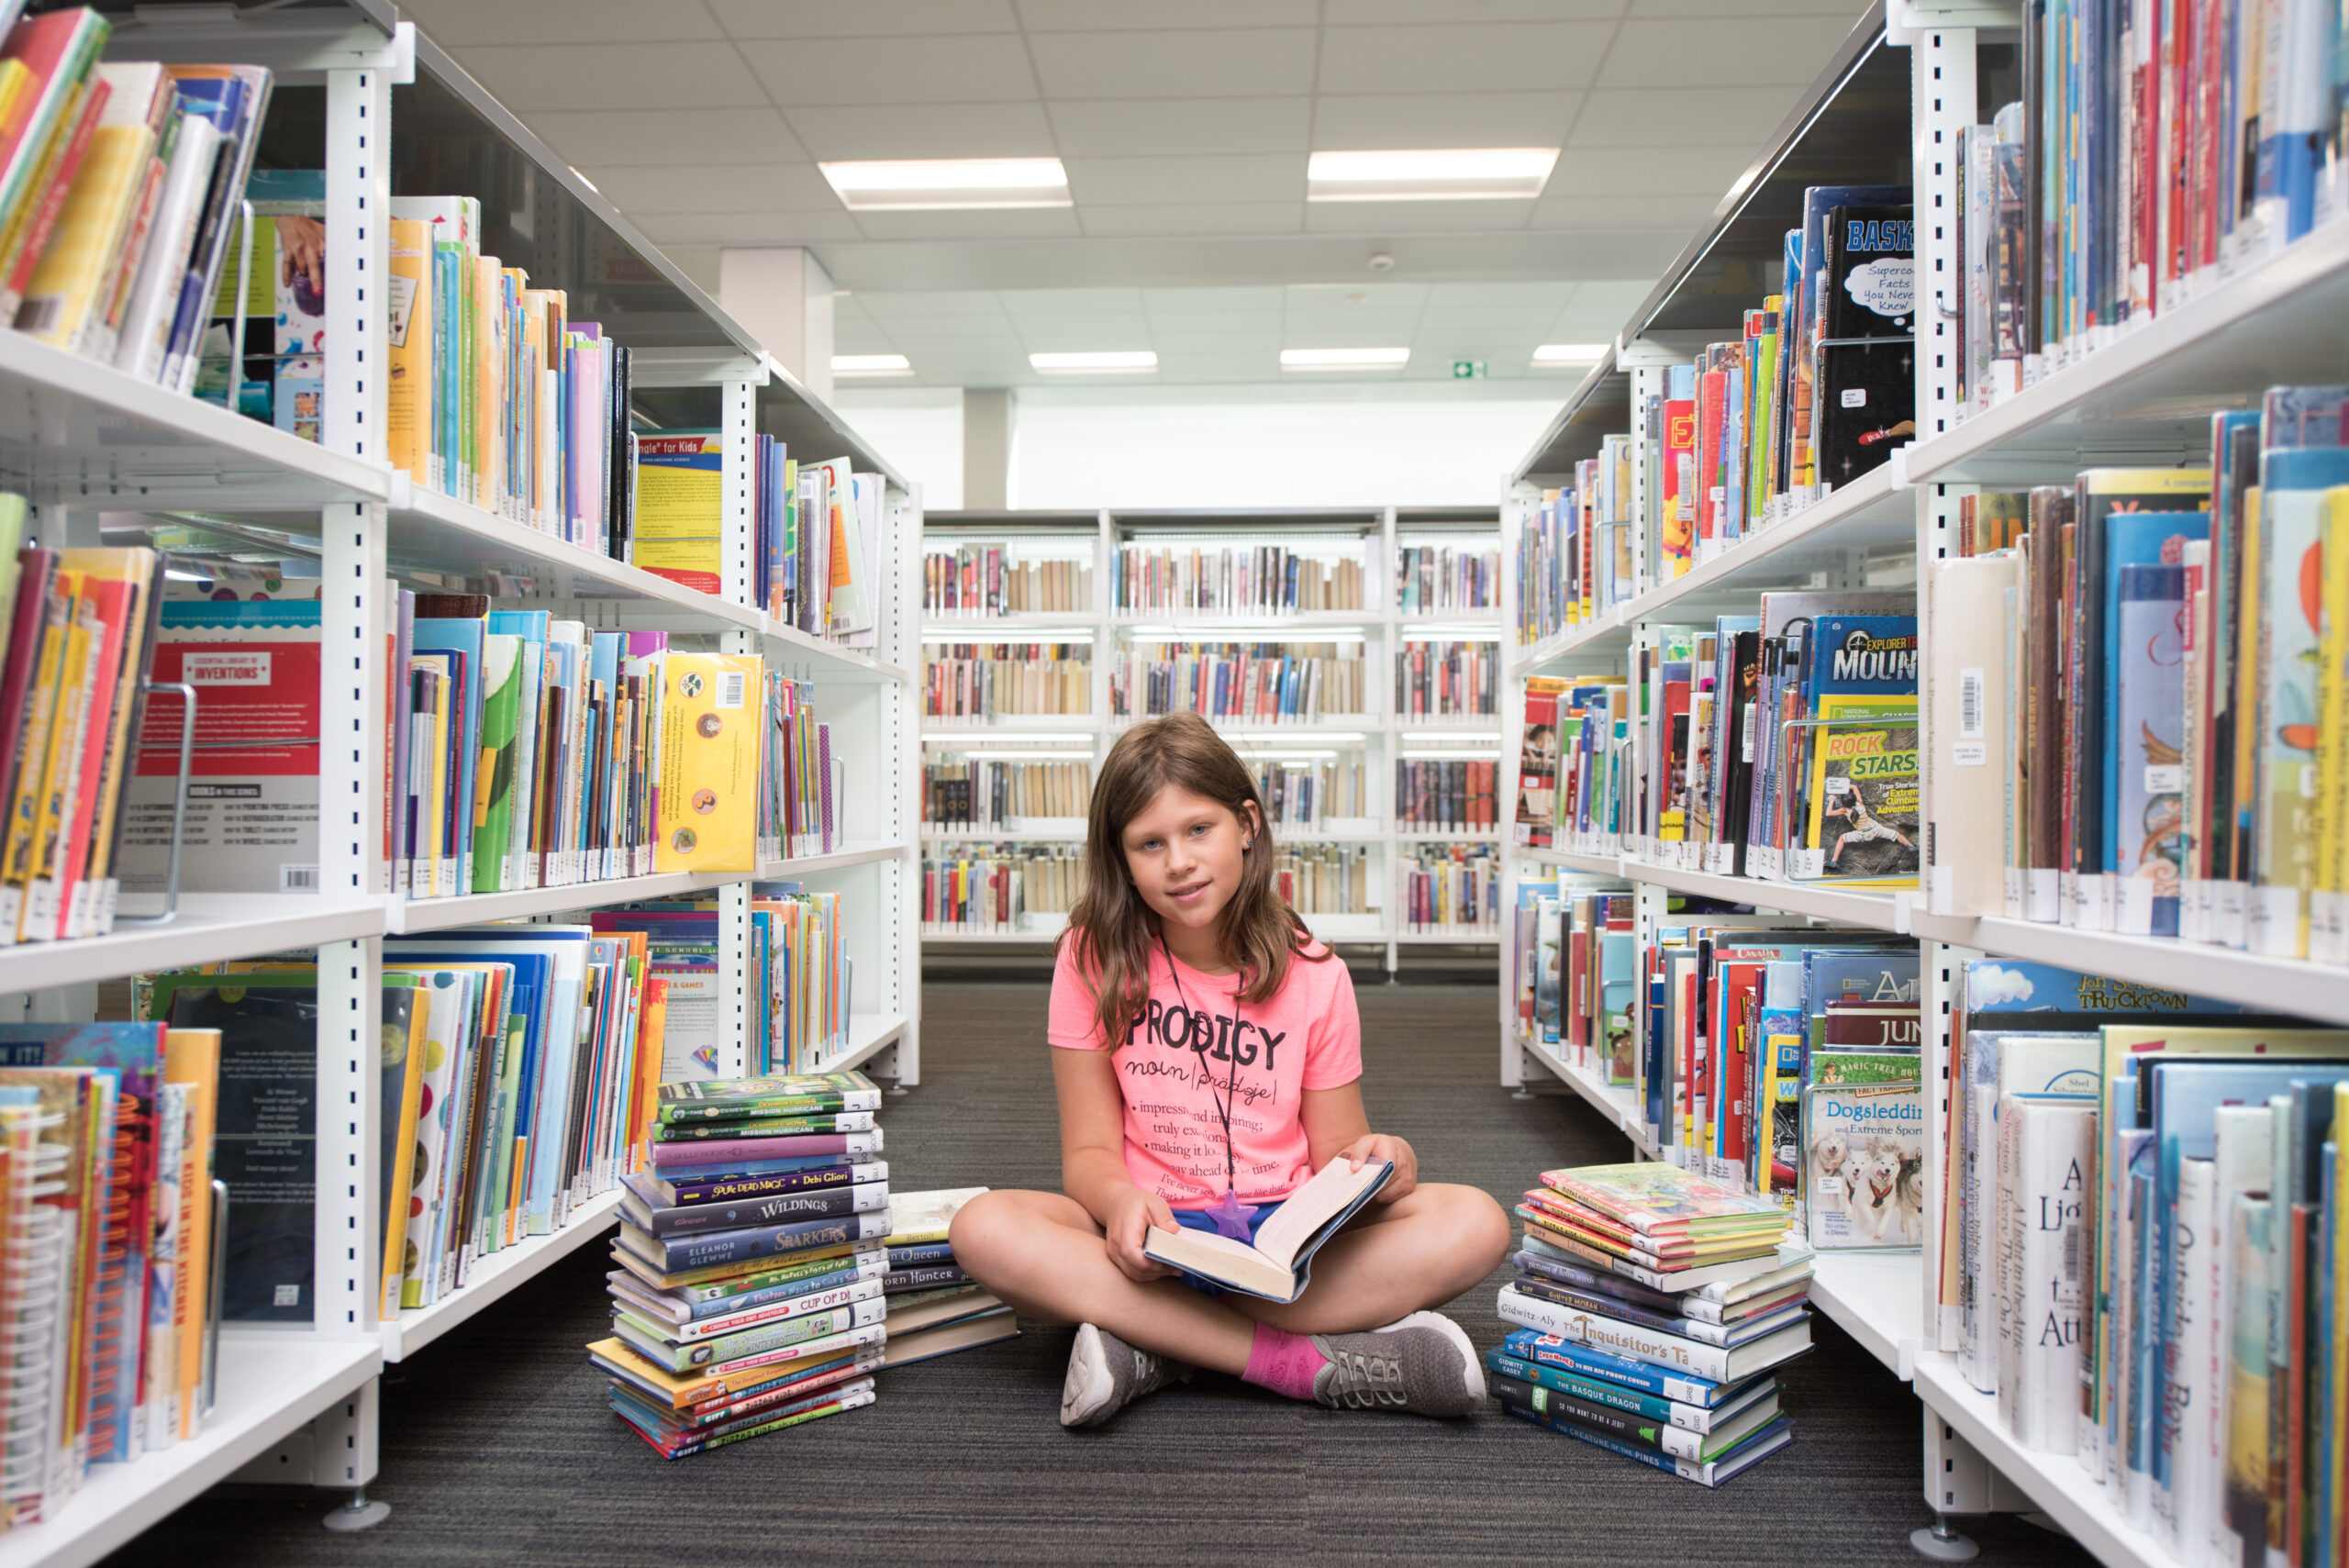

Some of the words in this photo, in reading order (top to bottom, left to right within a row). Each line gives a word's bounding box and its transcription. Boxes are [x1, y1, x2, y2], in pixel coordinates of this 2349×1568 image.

[1868, 266, 1915, 278] Superco
[1879, 279, 1909, 288] Facts
[1865, 290, 1884, 303] You
[1879, 301, 1909, 310] Knew
[663, 442, 676, 453] for
[679, 441, 697, 452] Kids
[195, 666, 258, 680] INVENTIONS
[1828, 734, 1883, 757] ROCK
[384, 777, 393, 834] together
[1887, 796, 1919, 805] Climbin
[1765, 803, 1773, 843] HANDBOOK
[2077, 975, 2107, 992] Jon
[2079, 990, 2188, 1010] TRUCKTOWN
[1126, 998, 1286, 1071] PRODIGY
[1125, 1060, 1189, 1081] noun
[1840, 1062, 1868, 1073] MAGIC
[1874, 1062, 1898, 1075] TREE
[2068, 1079, 2089, 1087] Shel
[758, 1098, 817, 1108] DOUBLECROSS
[749, 1119, 807, 1129] DOUBLECROSS
[1850, 1125, 1893, 1135] Extreme
[1151, 1141, 1191, 1159] making
[1193, 1143, 1203, 1155] it
[2001, 1109, 2012, 1173] Silverstein
[1189, 1162, 1222, 1176] ahead
[1252, 1161, 1280, 1174] time.
[2063, 1157, 2082, 1191] A
[181, 1162, 195, 1200] KIDS
[1161, 1173, 1175, 1185] I've
[1177, 1180, 1197, 1193] never
[1253, 1184, 1268, 1197] like
[180, 1205, 193, 1221] IN
[674, 1216, 708, 1227] Glewwe
[761, 1198, 828, 1219] WILDINGS
[178, 1227, 192, 1253] THE
[689, 1241, 735, 1257] ELEANOR
[774, 1225, 848, 1251] SPARKERS
[907, 1232, 934, 1241] Bertolt
[690, 1251, 732, 1266] GLEWWE
[901, 1249, 941, 1262] Queen
[781, 1270, 809, 1281] MARVEL'S
[808, 1266, 824, 1276] FISTS
[1529, 1260, 1551, 1273] pictures
[1552, 1265, 1558, 1273] of
[1558, 1268, 1575, 1279] hollis
[1575, 1273, 1595, 1284] woods
[174, 1260, 190, 1327] KITCHEN
[800, 1296, 821, 1310] CUP
[824, 1294, 838, 1305] OF
[1501, 1304, 1535, 1320] Gidwitz
[1539, 1309, 1556, 1328] Aly
[1548, 1291, 1573, 1305] HUNTER
[1574, 1297, 1598, 1310] MORAN
[1633, 1313, 1666, 1329] UNIVERSE
[1564, 1321, 1580, 1334] The
[1570, 1315, 1667, 1358] Inquisitor's
[718, 1348, 742, 1360] SILAS
[745, 1331, 808, 1352] WINTERBOTTOM
[1498, 1358, 1524, 1370] GIDWITZ
[1671, 1346, 1689, 1365] Ta
[1502, 1365, 1521, 1376] CASEY
[1583, 1364, 1594, 1373] HIS
[1594, 1367, 1606, 1375] BIG
[1606, 1370, 1628, 1381] PHONY
[1628, 1375, 1651, 1387] COUSIN
[705, 1410, 726, 1423] GIFF
[745, 1396, 774, 1409] ZIGZAG
[774, 1389, 794, 1401] KIDS:
[817, 1374, 837, 1387] time
[1500, 1384, 1518, 1395] GIDWITZ
[1557, 1381, 1570, 1391] THE
[1572, 1385, 1605, 1401] BASQUE
[1607, 1396, 1641, 1411] DRAGON
[686, 1432, 707, 1444] GIFF
[728, 1419, 757, 1432] ZIGZAG
[758, 1412, 779, 1424] KIDS:
[807, 1396, 830, 1407] feet
[1511, 1406, 1535, 1418] GIDWITZ
[1559, 1402, 1564, 1410] SO
[1565, 1405, 1575, 1414] YOU
[1576, 1407, 1589, 1418] WANT
[1591, 1410, 1598, 1419] TO
[1598, 1413, 1605, 1421] BE
[1610, 1416, 1625, 1429] JEDI?
[676, 1446, 698, 1458] GIFF
[720, 1431, 751, 1445] ZIGZAG
[753, 1425, 774, 1437] KIDS:
[777, 1420, 795, 1431] sky
[798, 1412, 817, 1424] high
[1556, 1423, 1568, 1433] THE
[1569, 1427, 1609, 1449] CREATURE
[1620, 1445, 1633, 1455] THE
[1635, 1451, 1660, 1466] PINES
